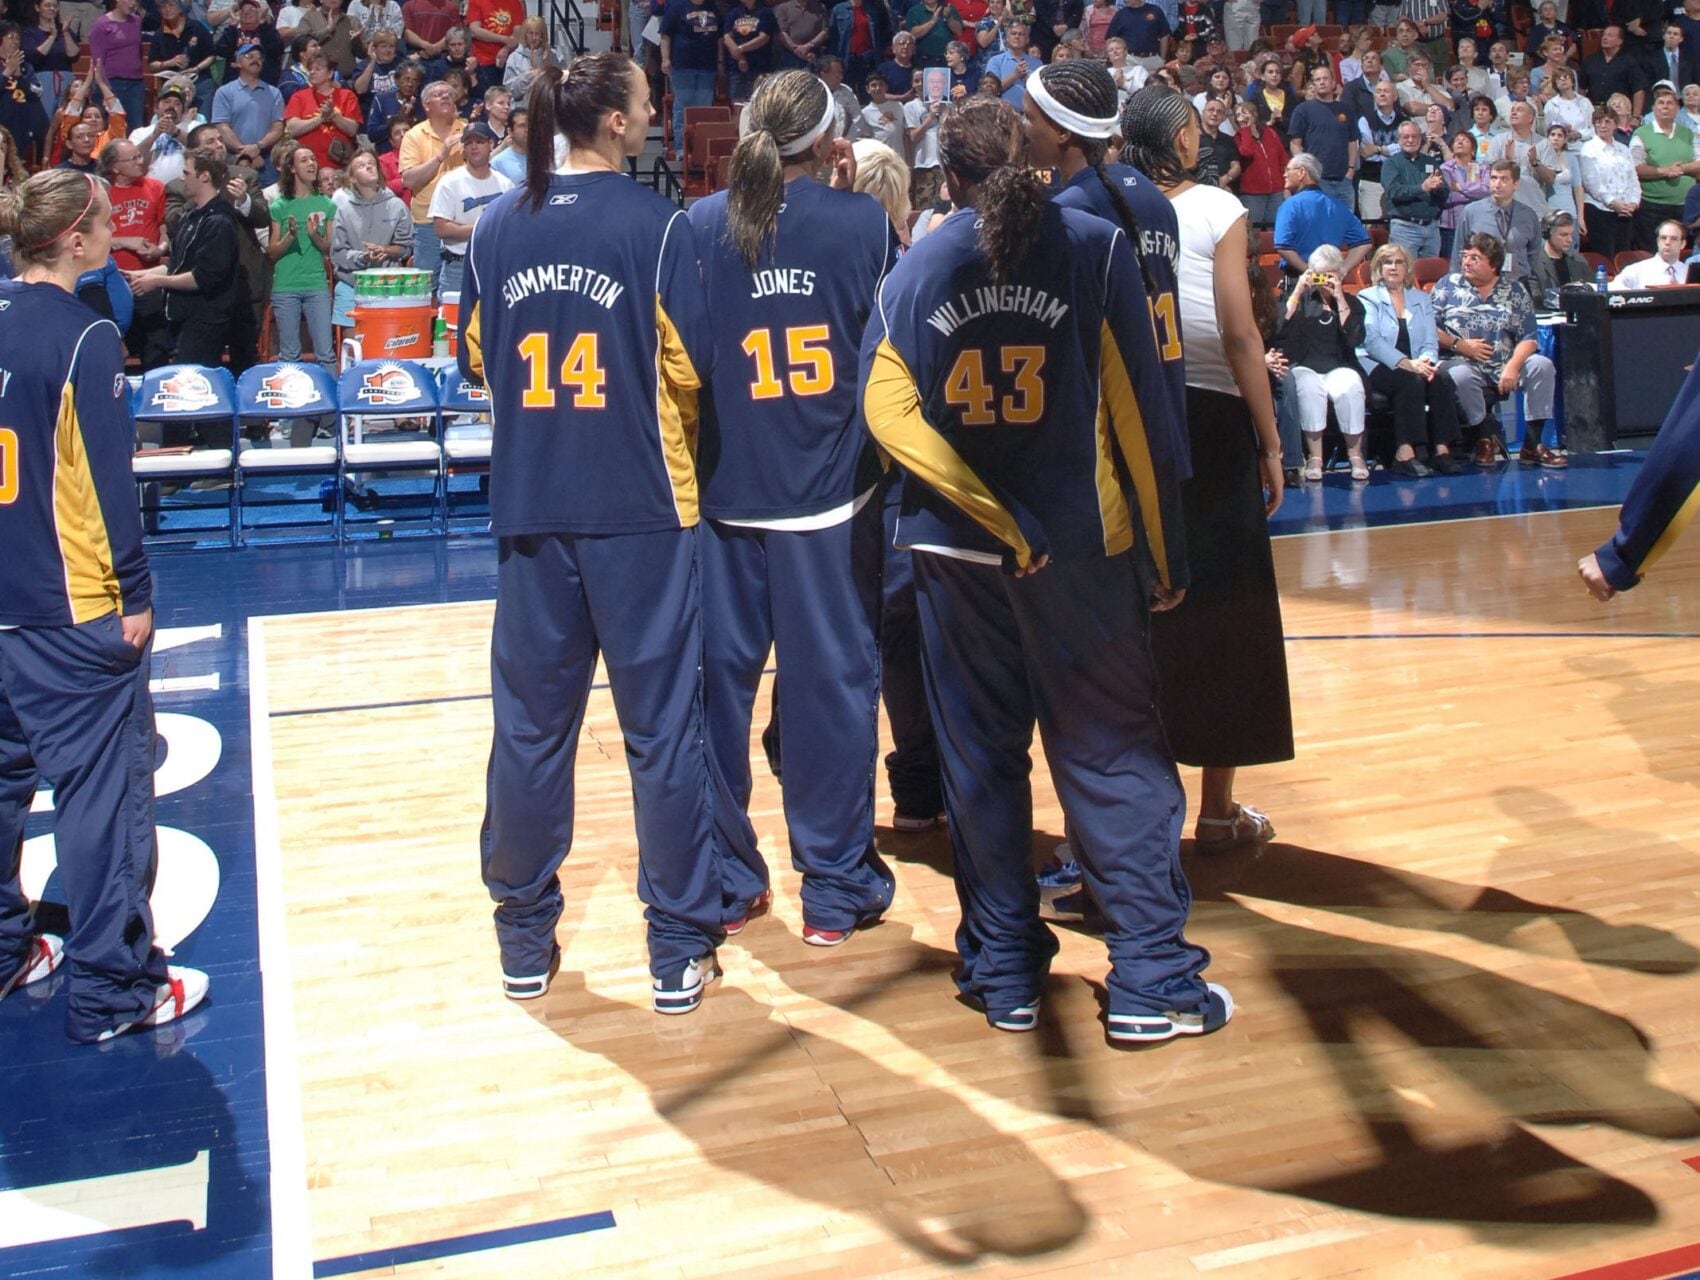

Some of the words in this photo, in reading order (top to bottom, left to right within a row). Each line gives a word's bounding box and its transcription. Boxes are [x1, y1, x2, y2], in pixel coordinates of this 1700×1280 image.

[503, 264, 624, 309] SUMMERTON
[751, 268, 816, 299] JONES
[926, 284, 1069, 337] WILLINGHAM
[517, 332, 606, 408] 14
[741, 324, 835, 400] 15
[944, 344, 1046, 425] 43
